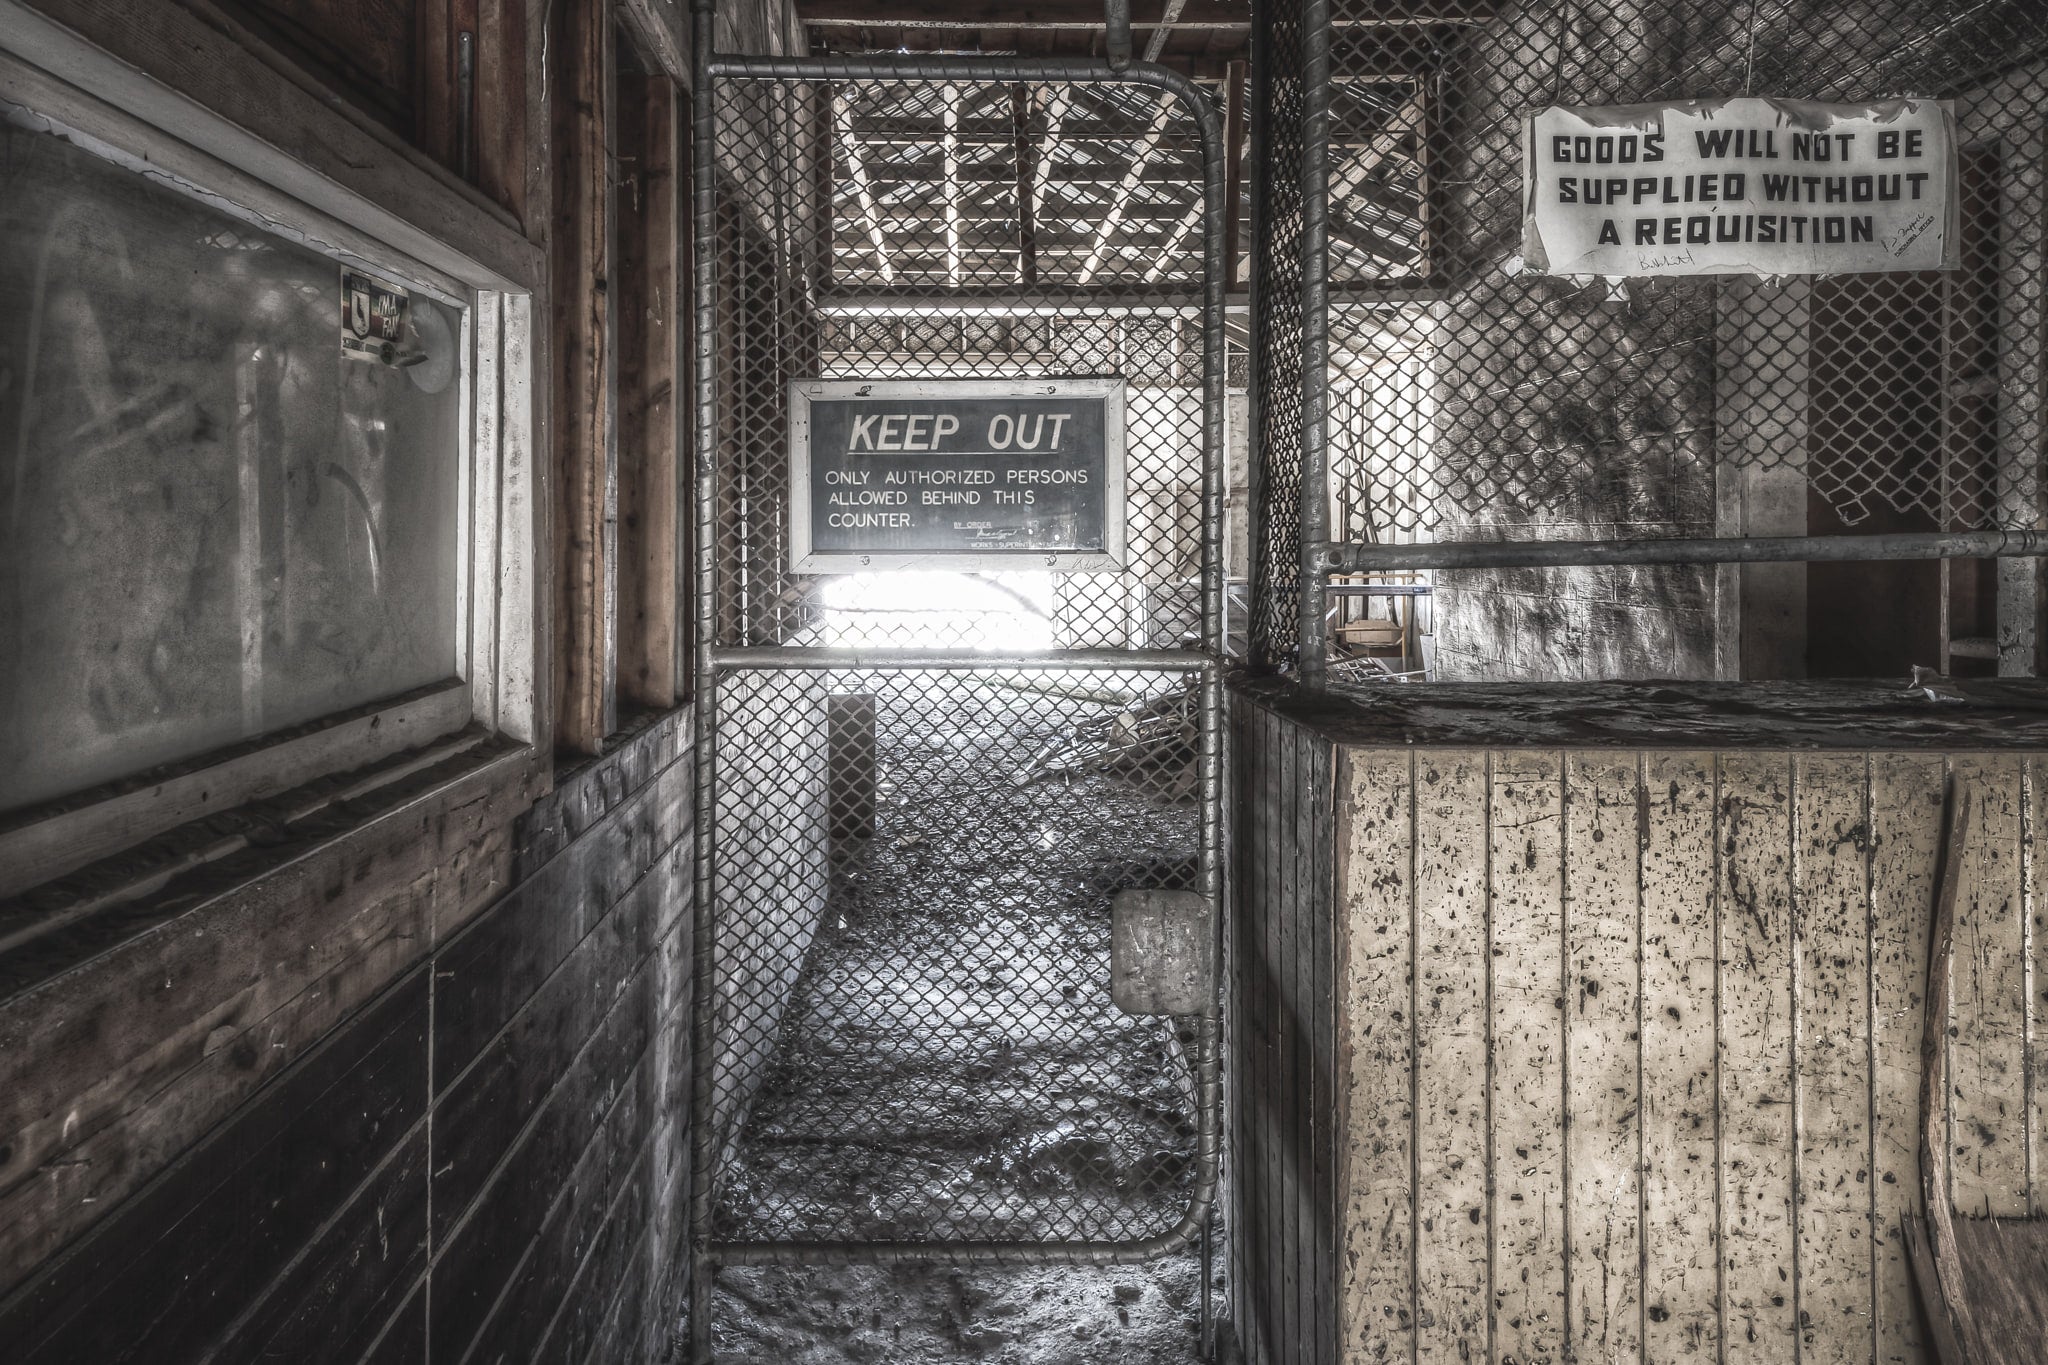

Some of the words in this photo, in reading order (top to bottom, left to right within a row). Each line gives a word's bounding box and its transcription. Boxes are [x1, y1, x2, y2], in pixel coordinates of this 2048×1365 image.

[1552, 133, 1665, 163] GOODS
[1695, 129, 1778, 159] WILL
[1793, 133, 1855, 162] NOT
[1877, 130, 1923, 159] BE
[1559, 173, 1746, 205] SUPPLIED
[1763, 173, 1929, 202] WITHOUT
[1598, 219, 1620, 245] A
[1635, 216, 1874, 245] REQUISITION
[849, 414, 959, 450] KEEP
[988, 414, 1071, 450] OUT
[825, 471, 870, 485] ONLY
[885, 471, 995, 485] AUTHORIZED
[1007, 470, 1088, 484] PERSONS
[829, 491, 908, 505] ALLOWED
[922, 491, 981, 505] BEHIND
[993, 490, 1035, 504] THIS
[828, 513, 916, 527] COUNTER.
